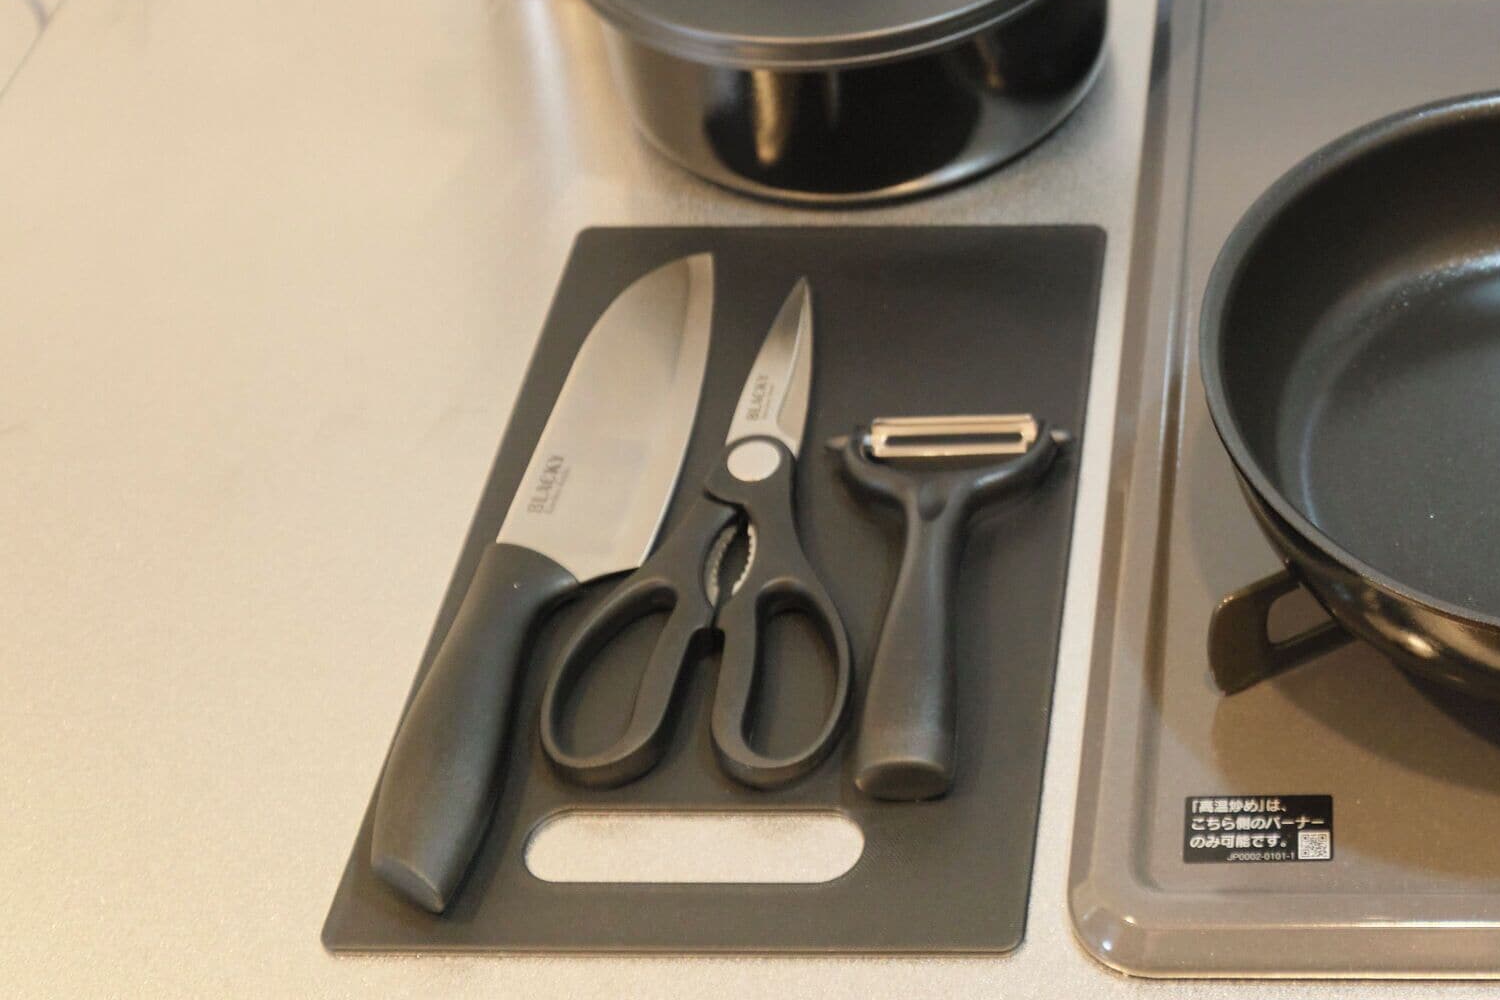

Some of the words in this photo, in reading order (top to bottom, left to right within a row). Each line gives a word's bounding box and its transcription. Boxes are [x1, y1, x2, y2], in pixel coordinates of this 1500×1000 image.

[527, 455, 564, 513] BLACKY
[1191, 817, 1325, 831] こちら側のバーナー
[1190, 834, 1287, 848] のみ可能です。
